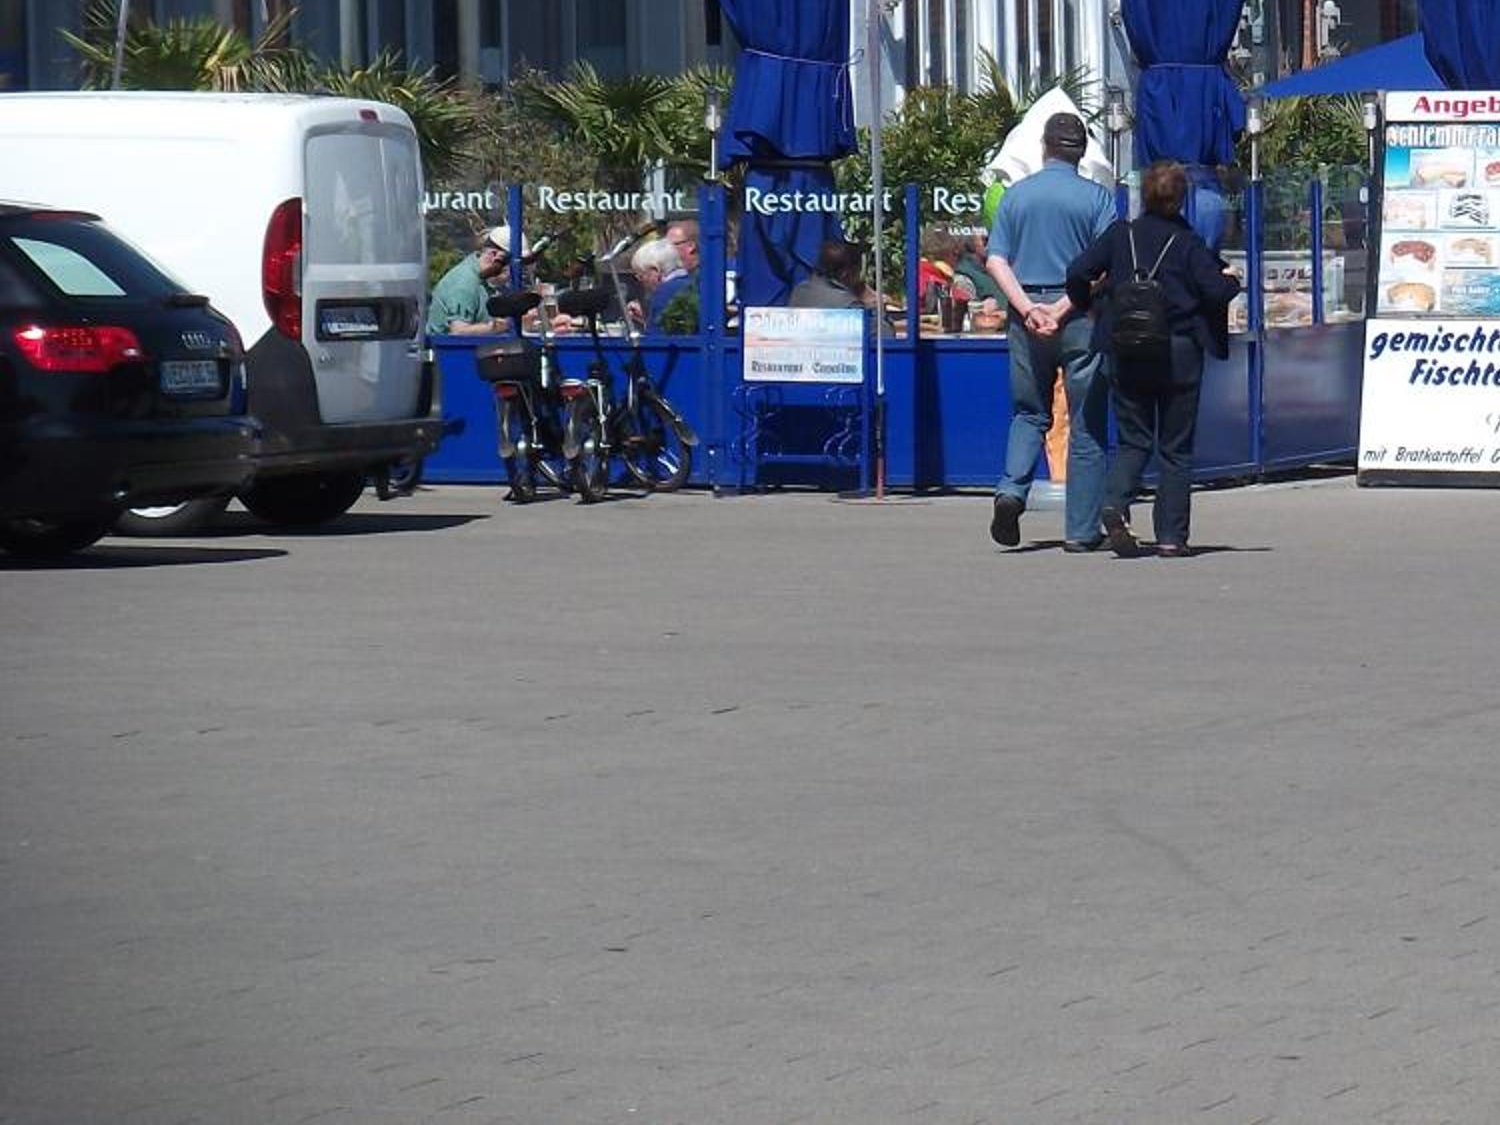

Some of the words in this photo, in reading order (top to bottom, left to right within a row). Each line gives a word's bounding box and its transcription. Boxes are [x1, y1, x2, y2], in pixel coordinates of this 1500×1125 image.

[538, 186, 685, 214] Restaurant
[1363, 447, 1387, 463] mit
[1394, 446, 1485, 464] Bratkartoffel
